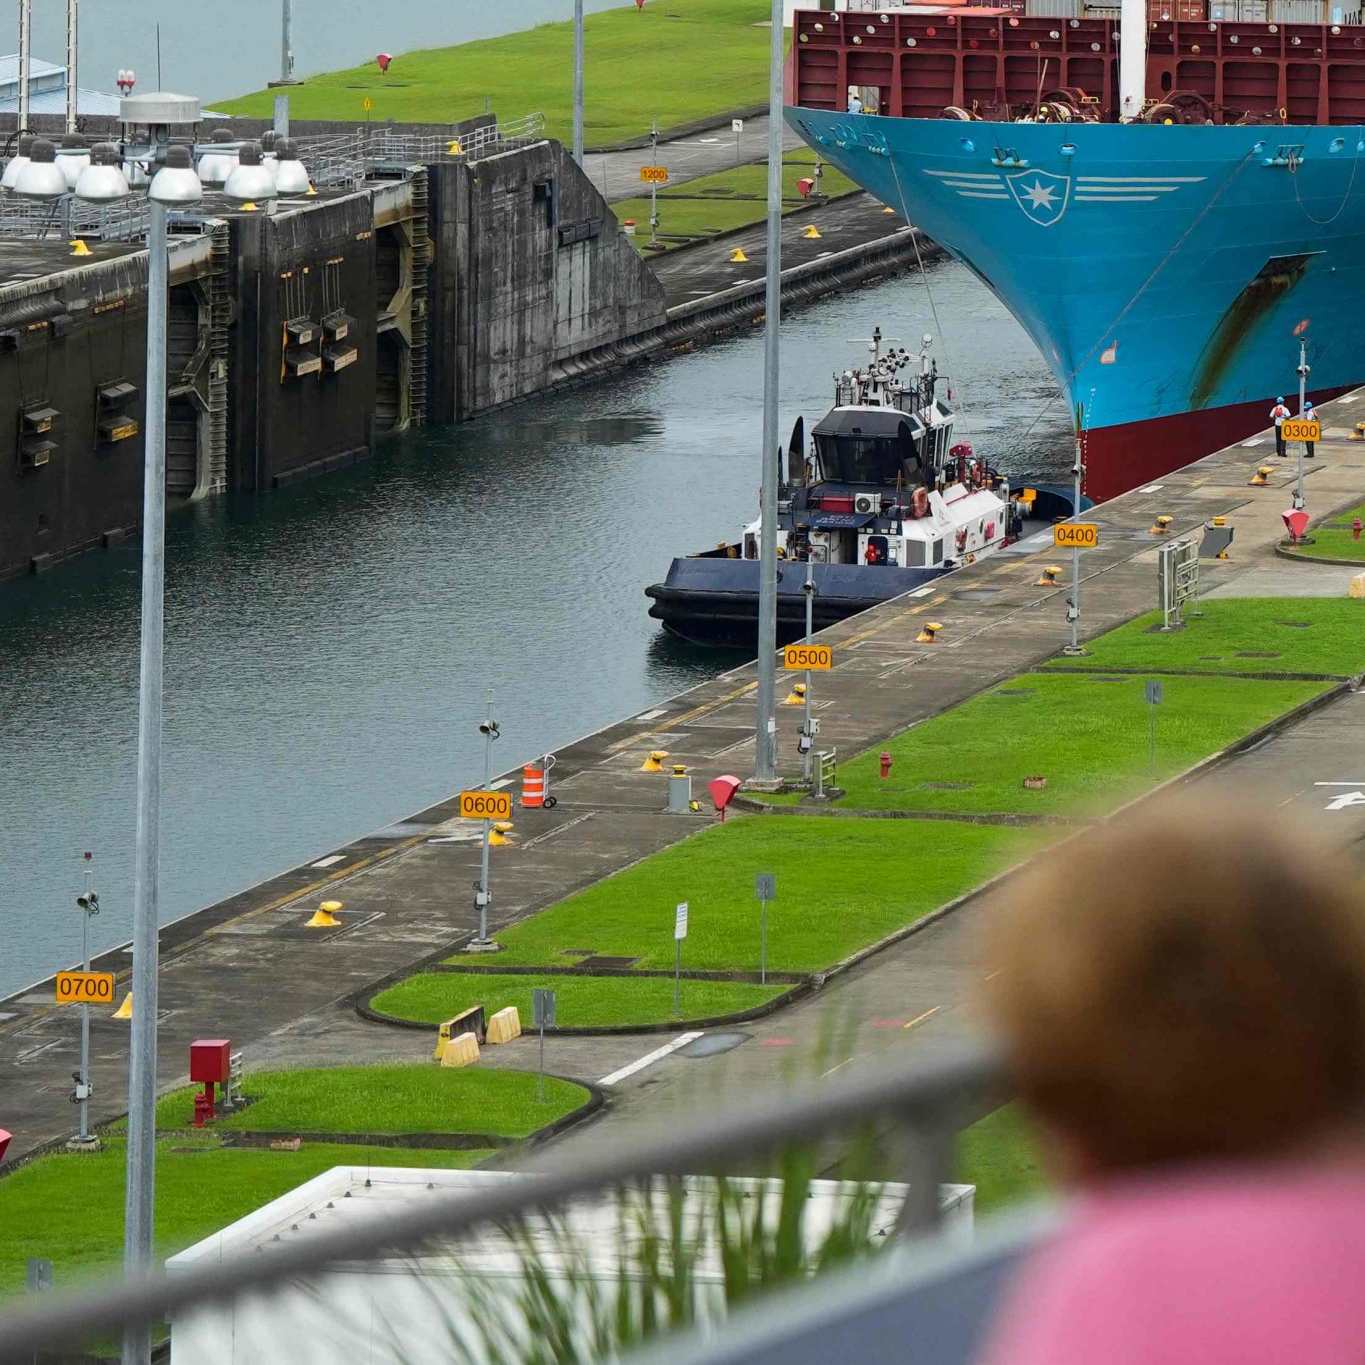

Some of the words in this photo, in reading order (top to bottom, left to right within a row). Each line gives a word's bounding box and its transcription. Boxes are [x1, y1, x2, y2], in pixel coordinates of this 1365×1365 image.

[643, 170, 665, 179] 1200
[1283, 424, 1318, 438] 0300
[1057, 527, 1094, 542] 0400
[787, 649, 828, 665] 0500
[463, 796, 508, 814] 0600
[60, 978, 109, 997] 0700
